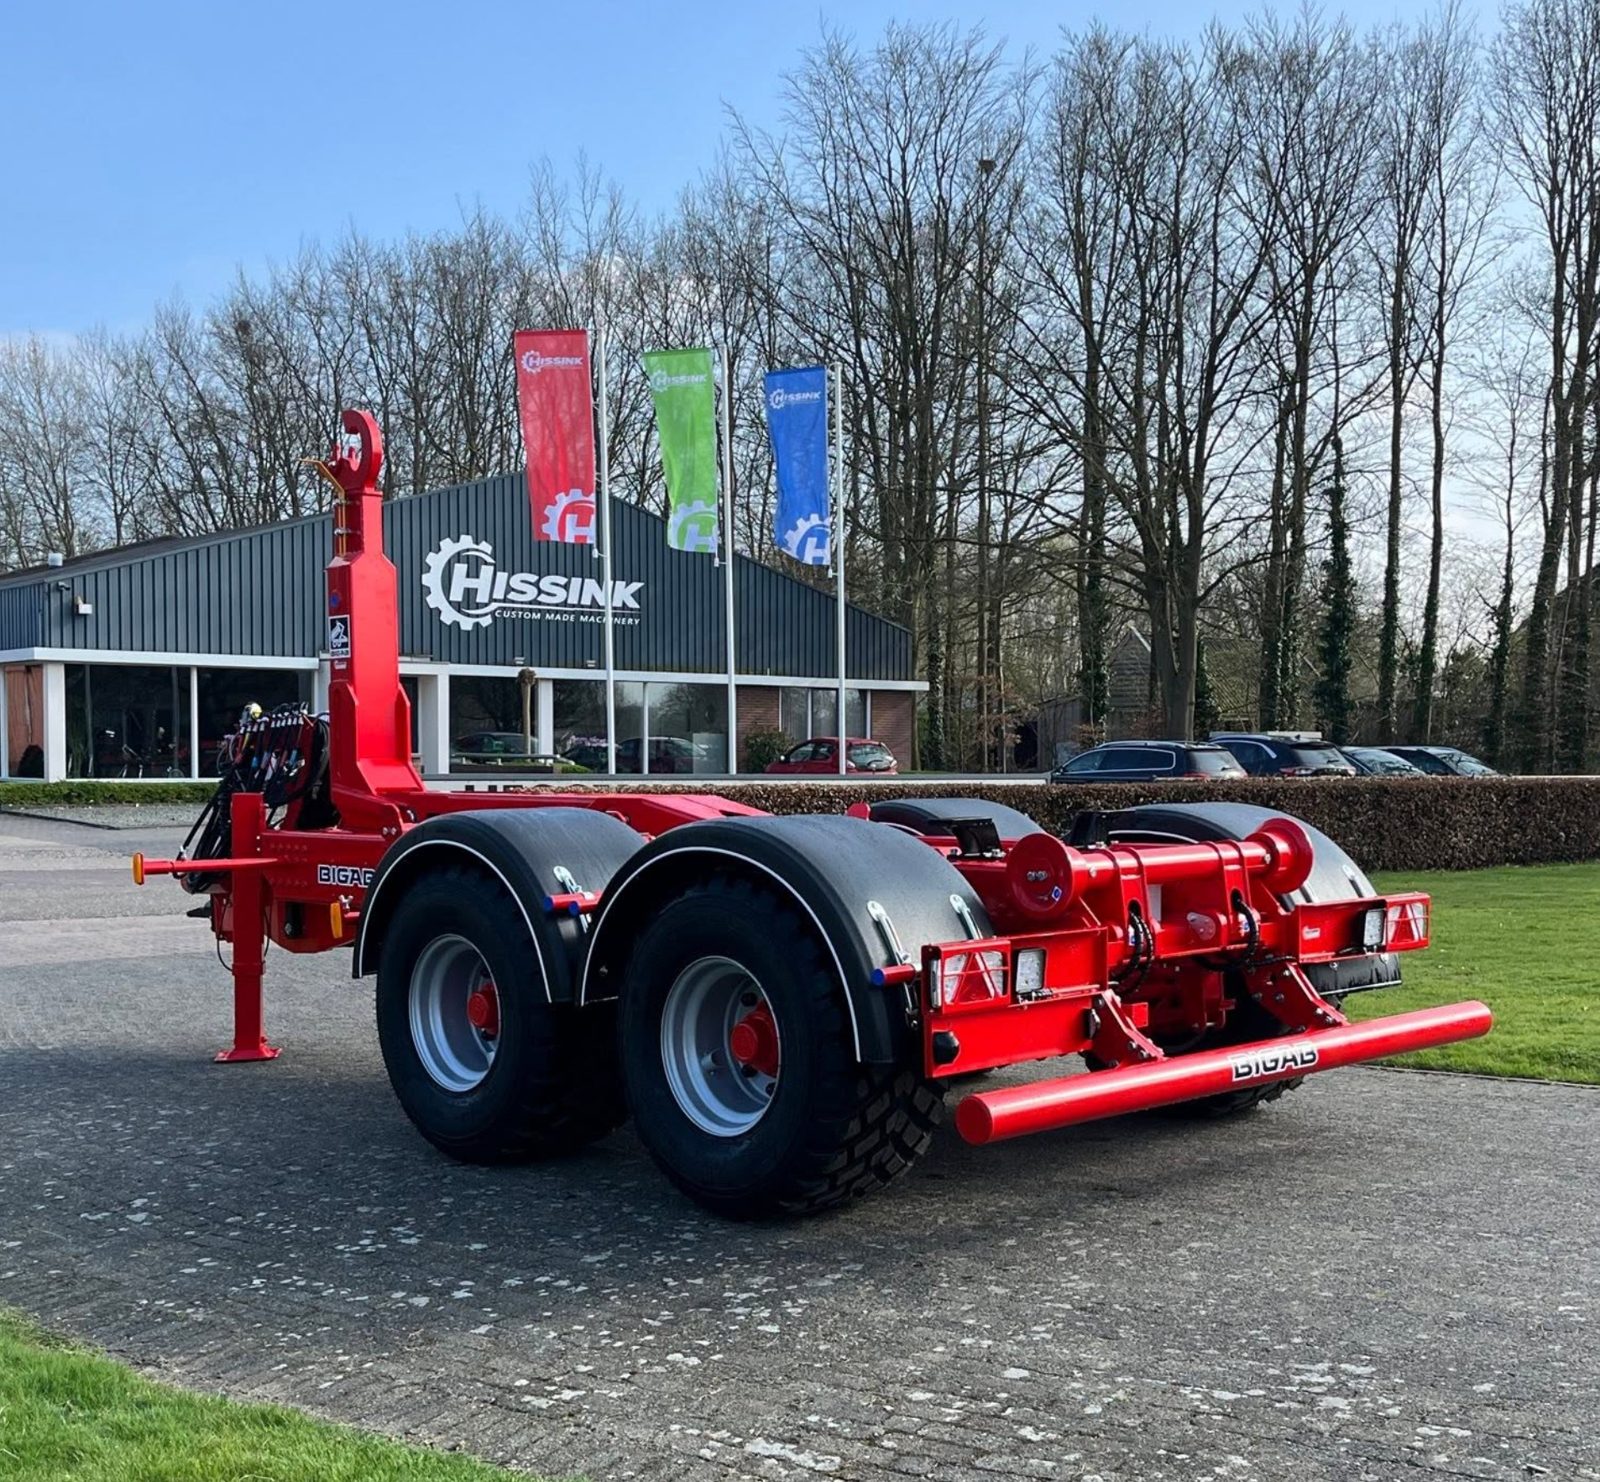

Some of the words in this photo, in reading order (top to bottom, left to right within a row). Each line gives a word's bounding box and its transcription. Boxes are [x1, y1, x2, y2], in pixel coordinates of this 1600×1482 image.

[528, 356, 583, 367] HISSINK
[449, 562, 645, 609] HISSINK
[494, 609, 541, 620] CUSTOM
[545, 612, 575, 622] MADE
[579, 614, 641, 626] MACNERY
[1229, 1042, 1318, 1081] BIGAB
